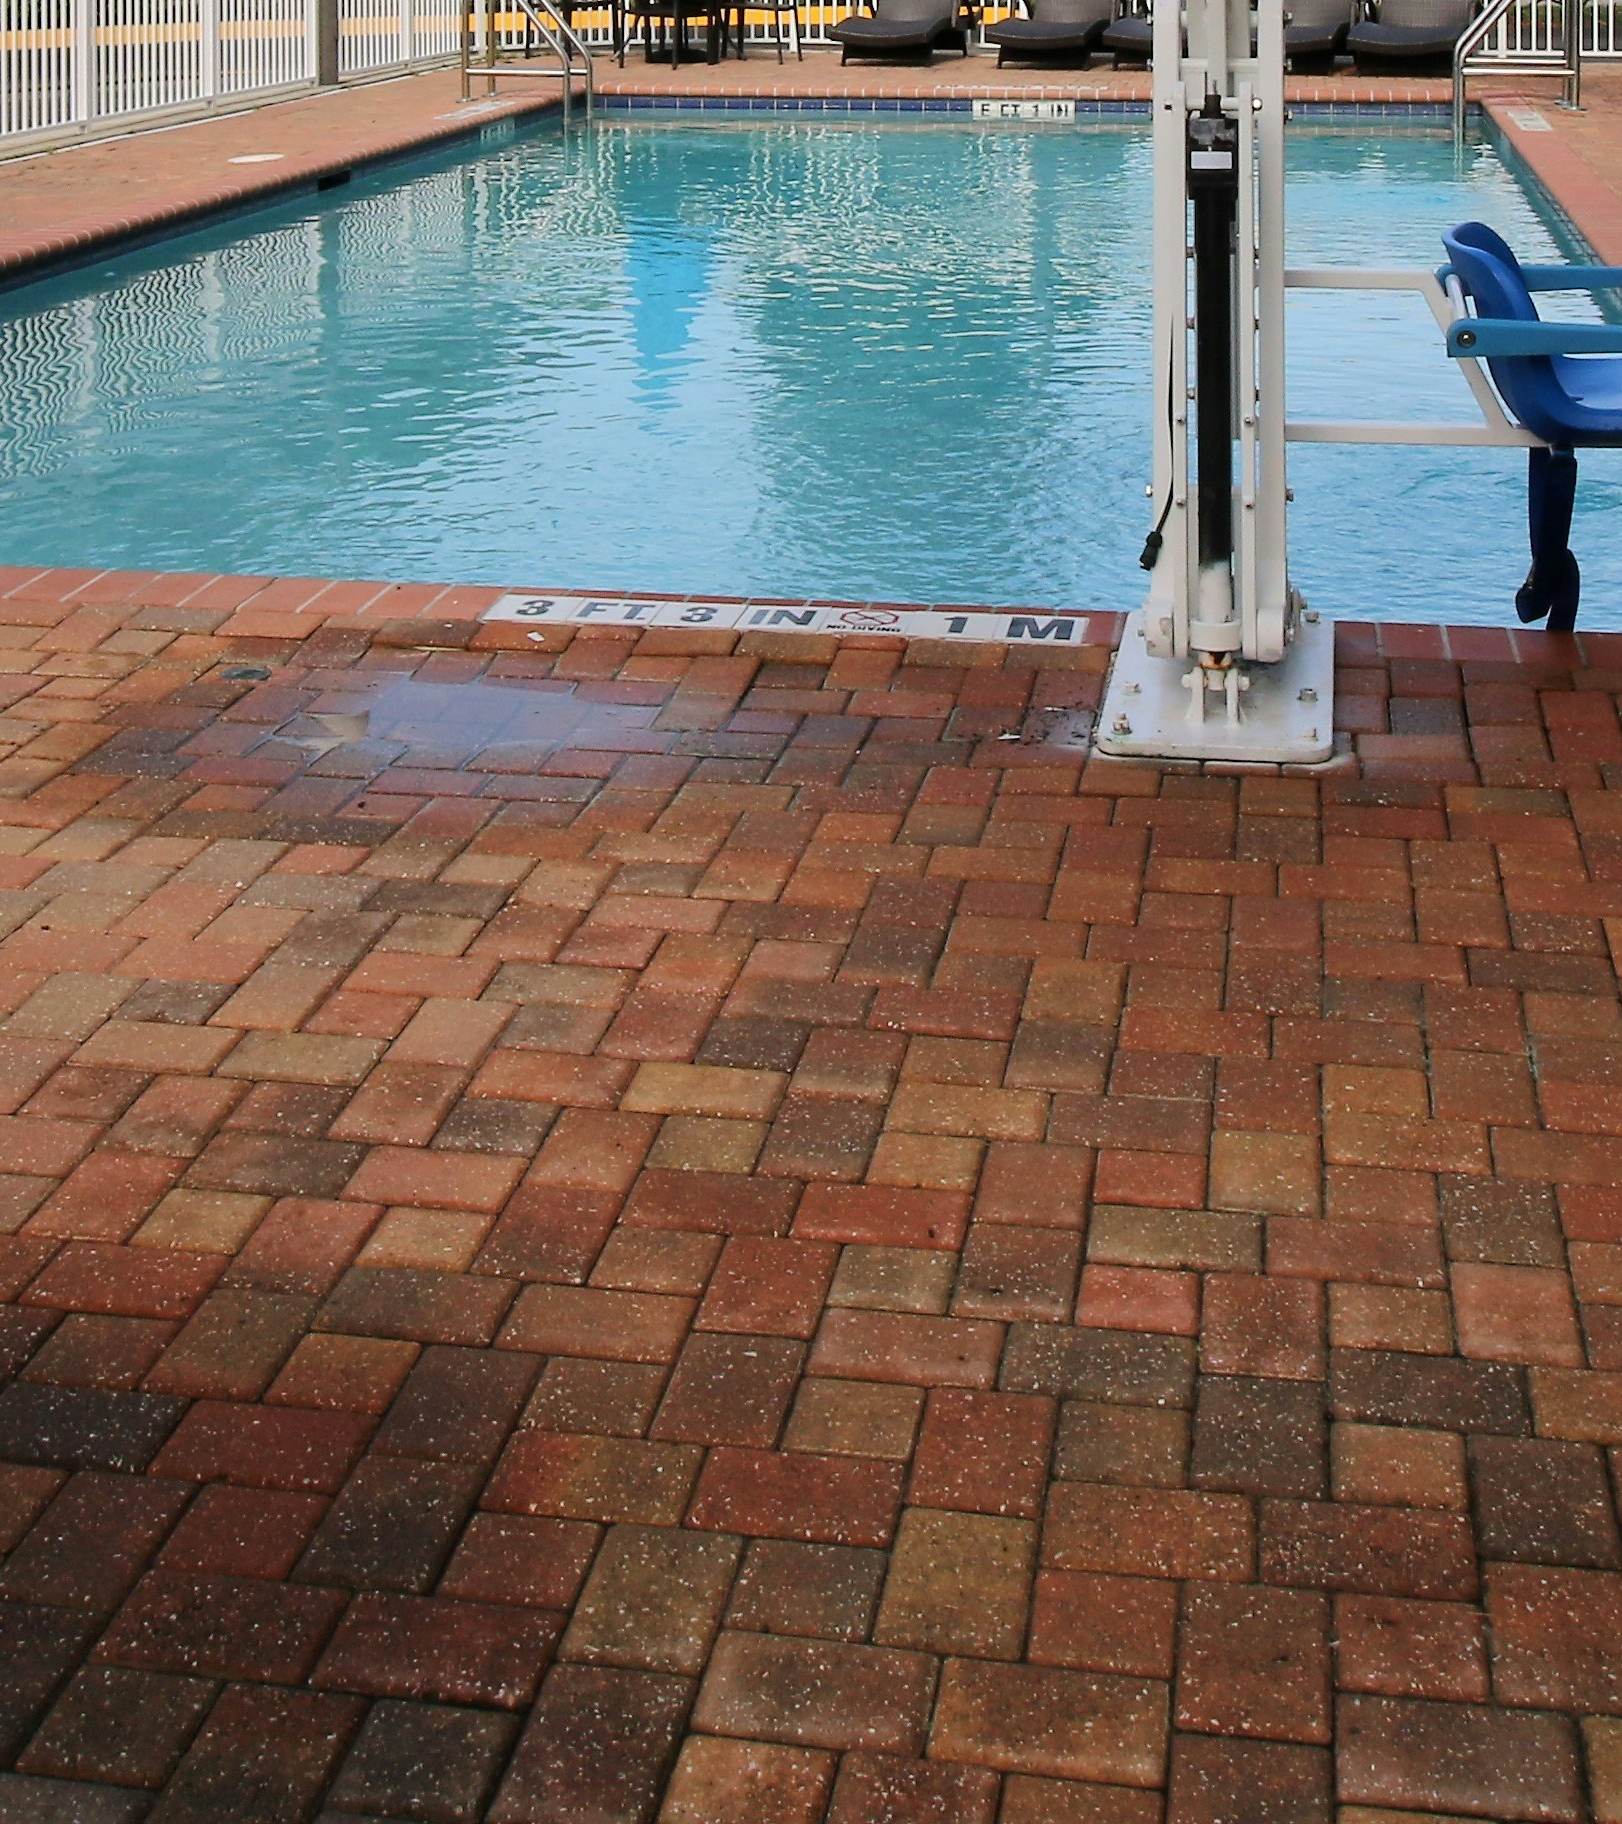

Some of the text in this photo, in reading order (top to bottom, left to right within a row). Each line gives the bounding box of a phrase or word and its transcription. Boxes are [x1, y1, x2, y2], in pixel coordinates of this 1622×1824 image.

[515, 600, 556, 616] 3
[680, 606, 718, 623] 3
[748, 609, 817, 625] IN
[943, 616, 969, 634] 1
[1006, 616, 1075, 641] M
